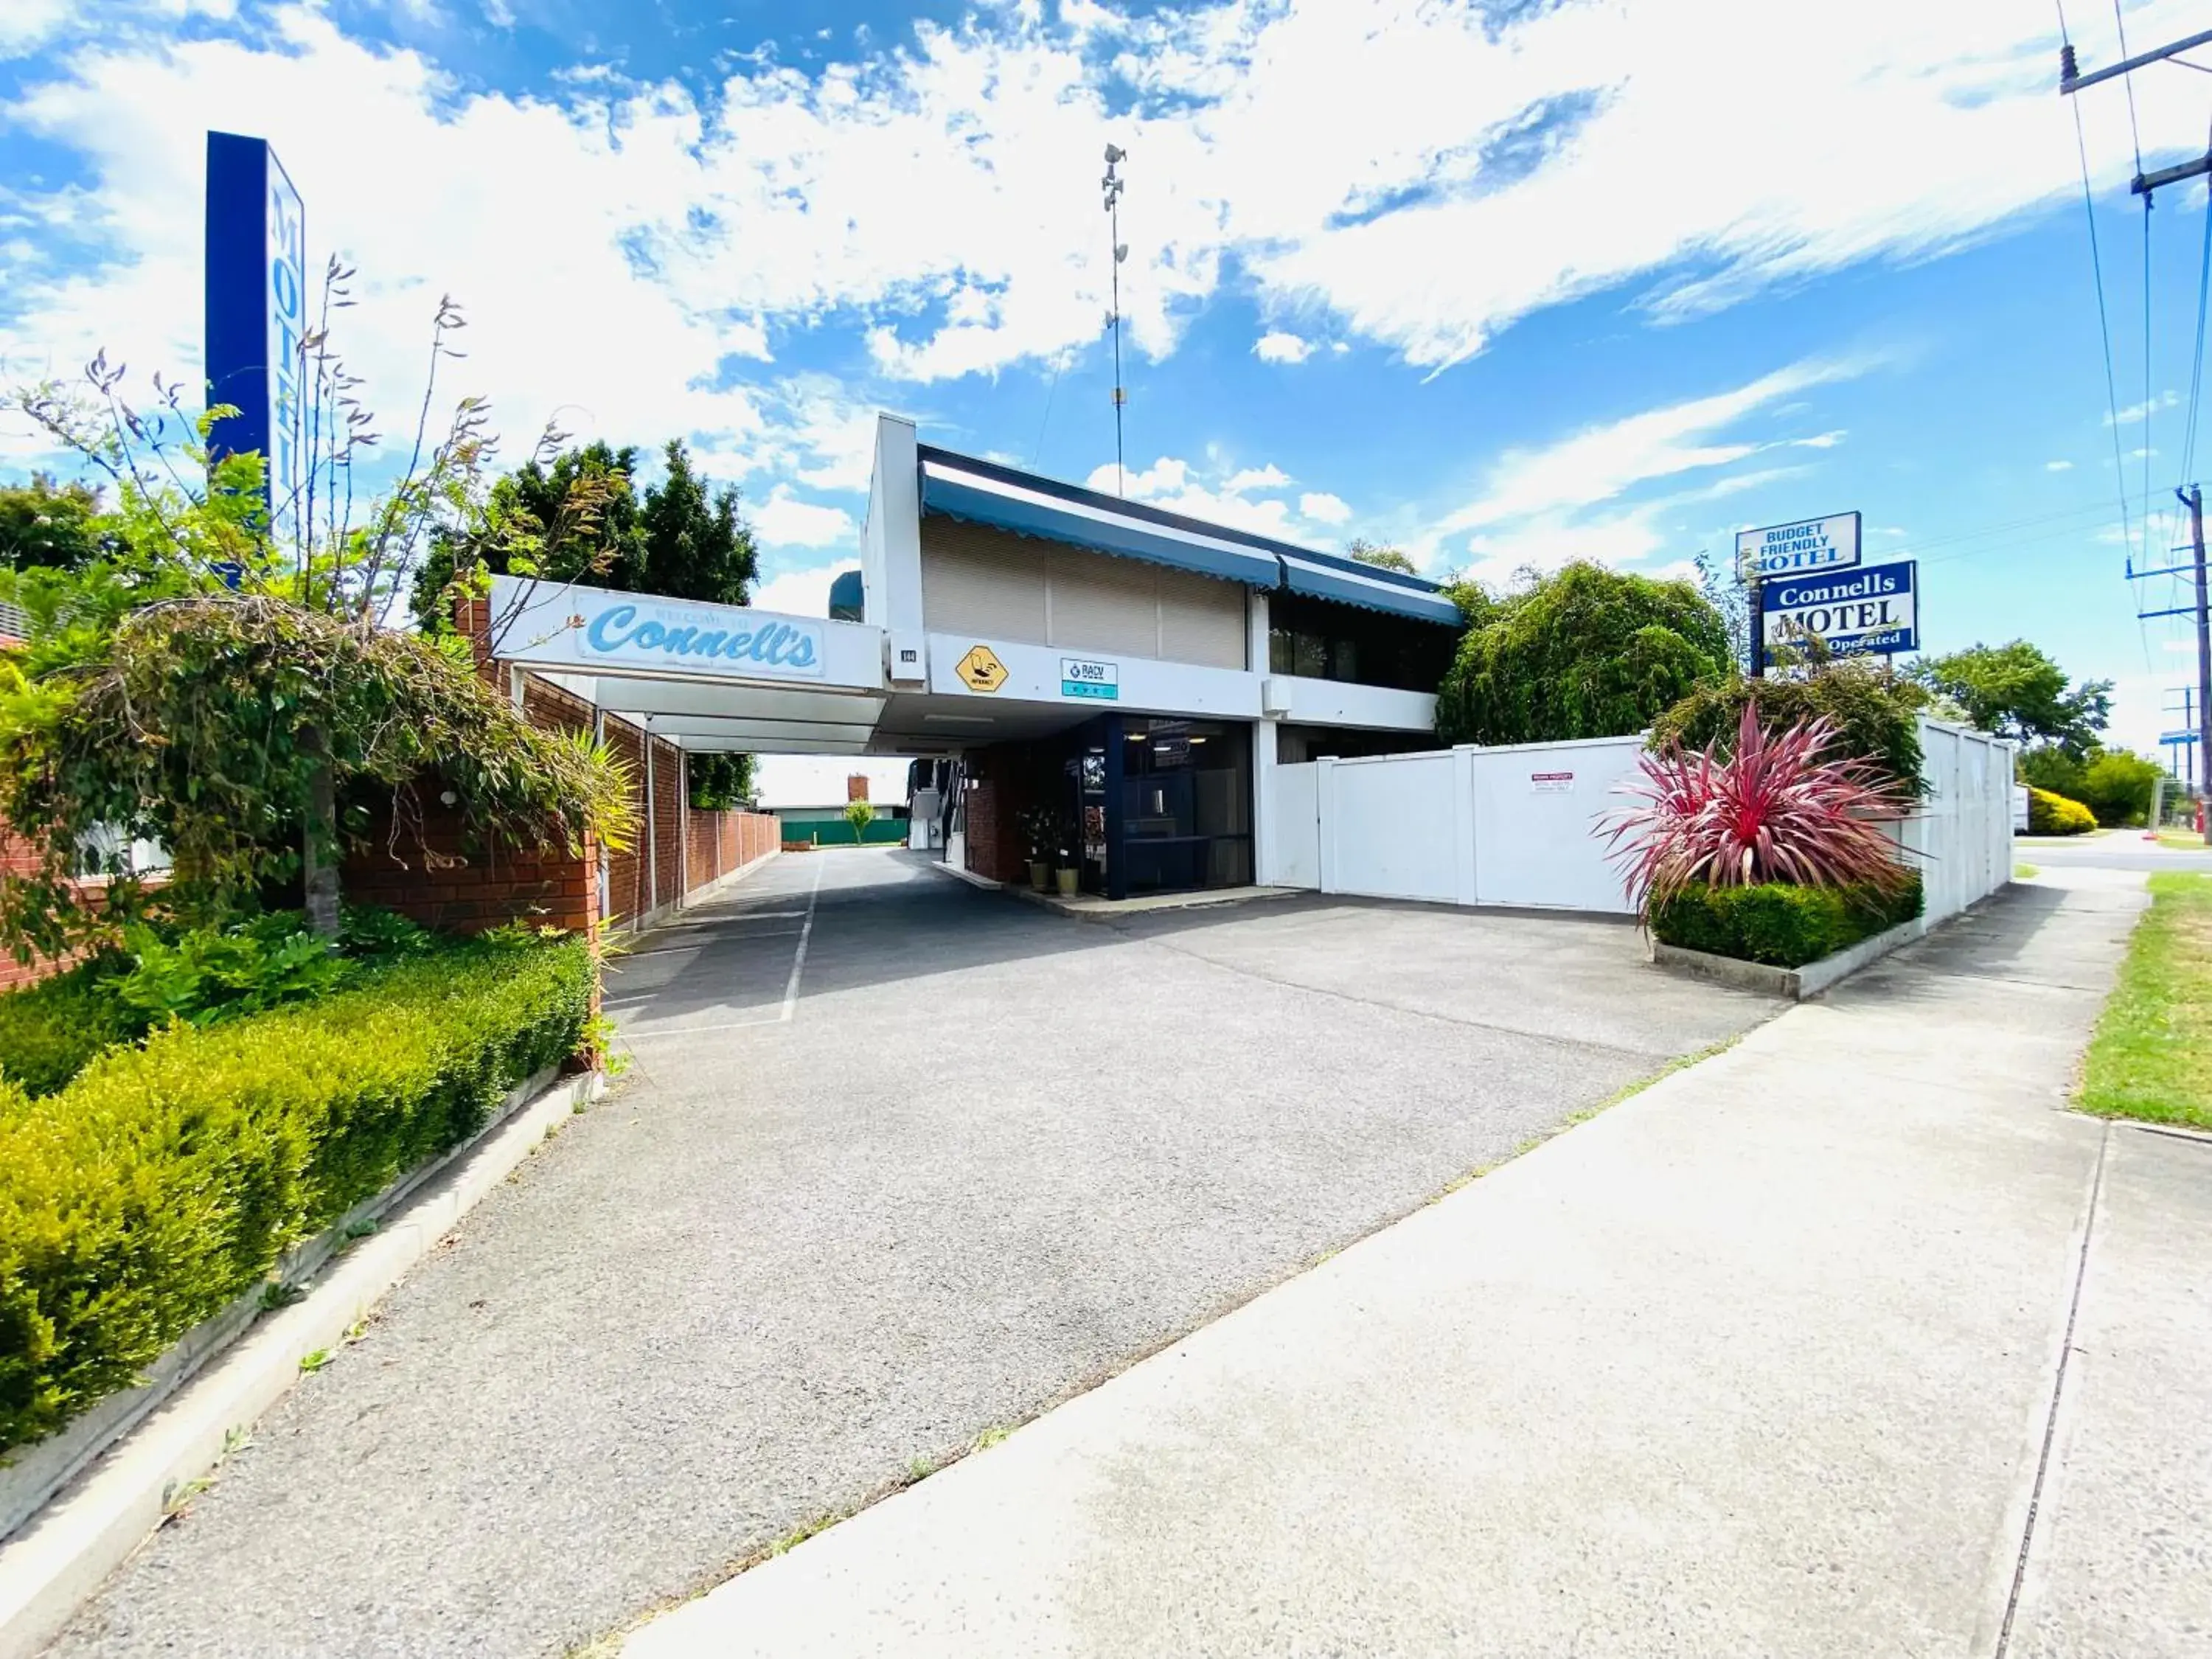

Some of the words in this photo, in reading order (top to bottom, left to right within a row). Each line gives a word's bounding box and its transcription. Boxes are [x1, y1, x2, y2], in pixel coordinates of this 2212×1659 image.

[1767, 523, 1824, 543] BUDGET
[1760, 535, 1829, 557] FRIENDLY
[1779, 573, 1896, 606] Connells
[586, 605, 816, 667] Connell's
[1082, 664, 1104, 675] RACV
